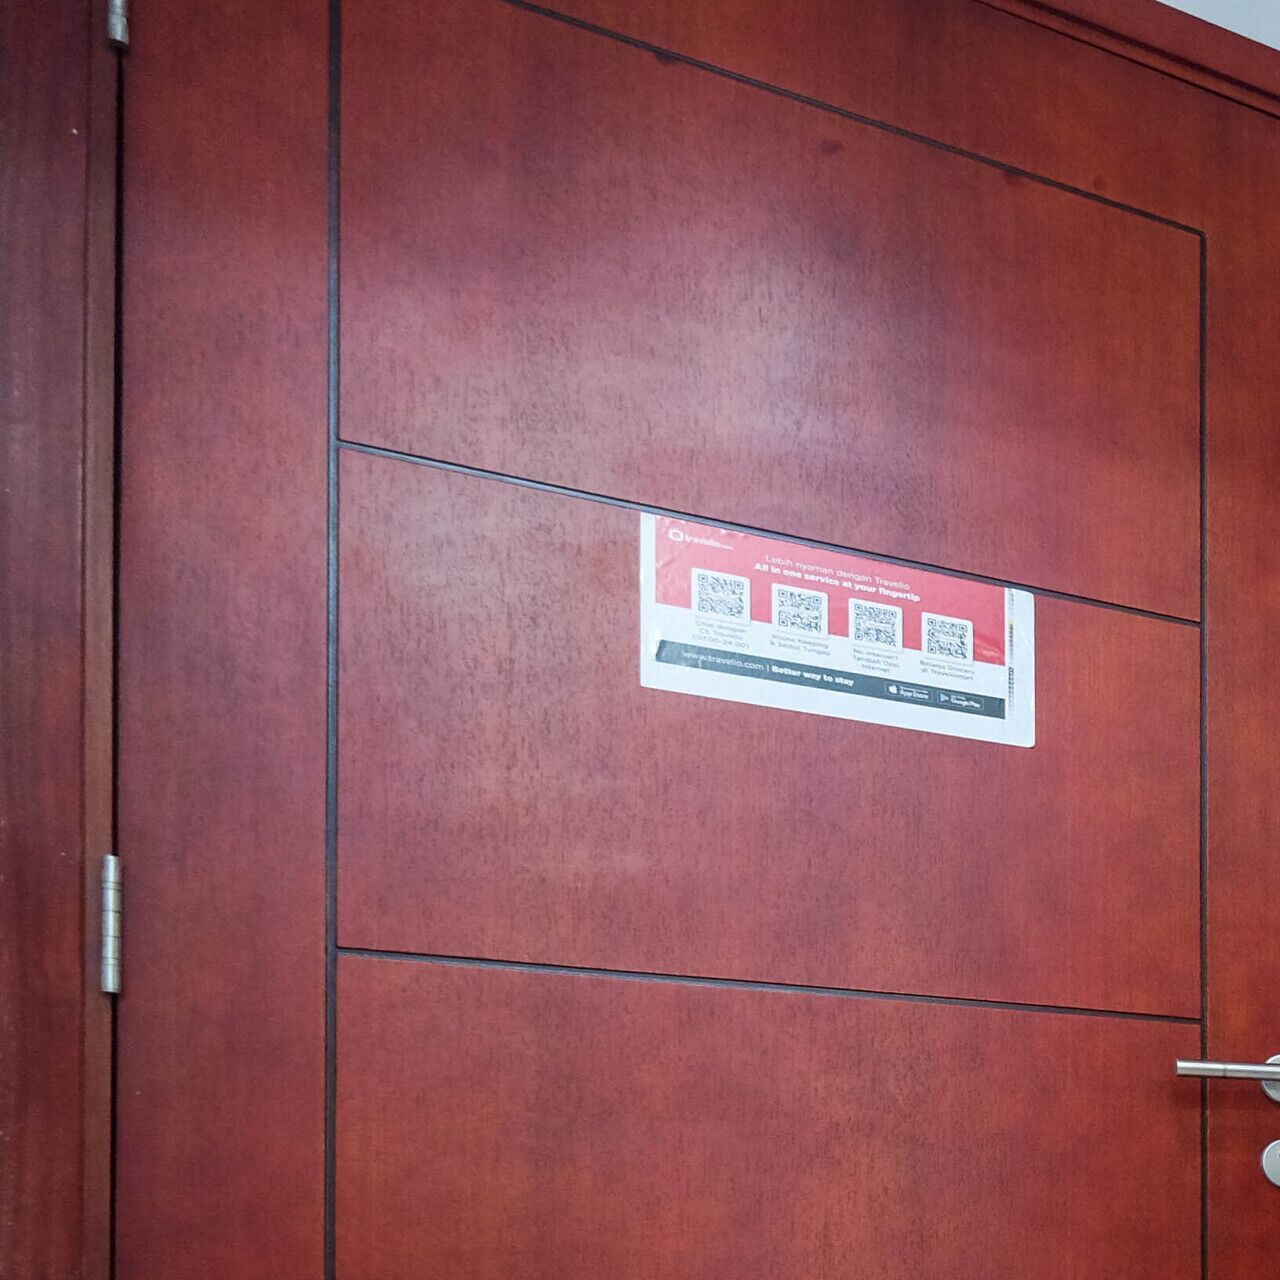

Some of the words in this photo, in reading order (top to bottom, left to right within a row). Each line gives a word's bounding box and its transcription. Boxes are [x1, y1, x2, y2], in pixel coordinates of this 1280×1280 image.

[754, 563, 769, 573] All
[783, 570, 802, 579] one
[804, 573, 840, 587] service
[842, 580, 852, 589] at
[854, 583, 877, 594] your
[878, 587, 921, 603] fingertip
[765, 555, 793, 568] Lebih
[796, 561, 834, 576] nyaman
[836, 568, 872, 584] dengan
[874, 577, 911, 591] Travelio
[803, 671, 822, 681] way
[823, 673, 833, 683] to
[835, 676, 855, 688] stay
